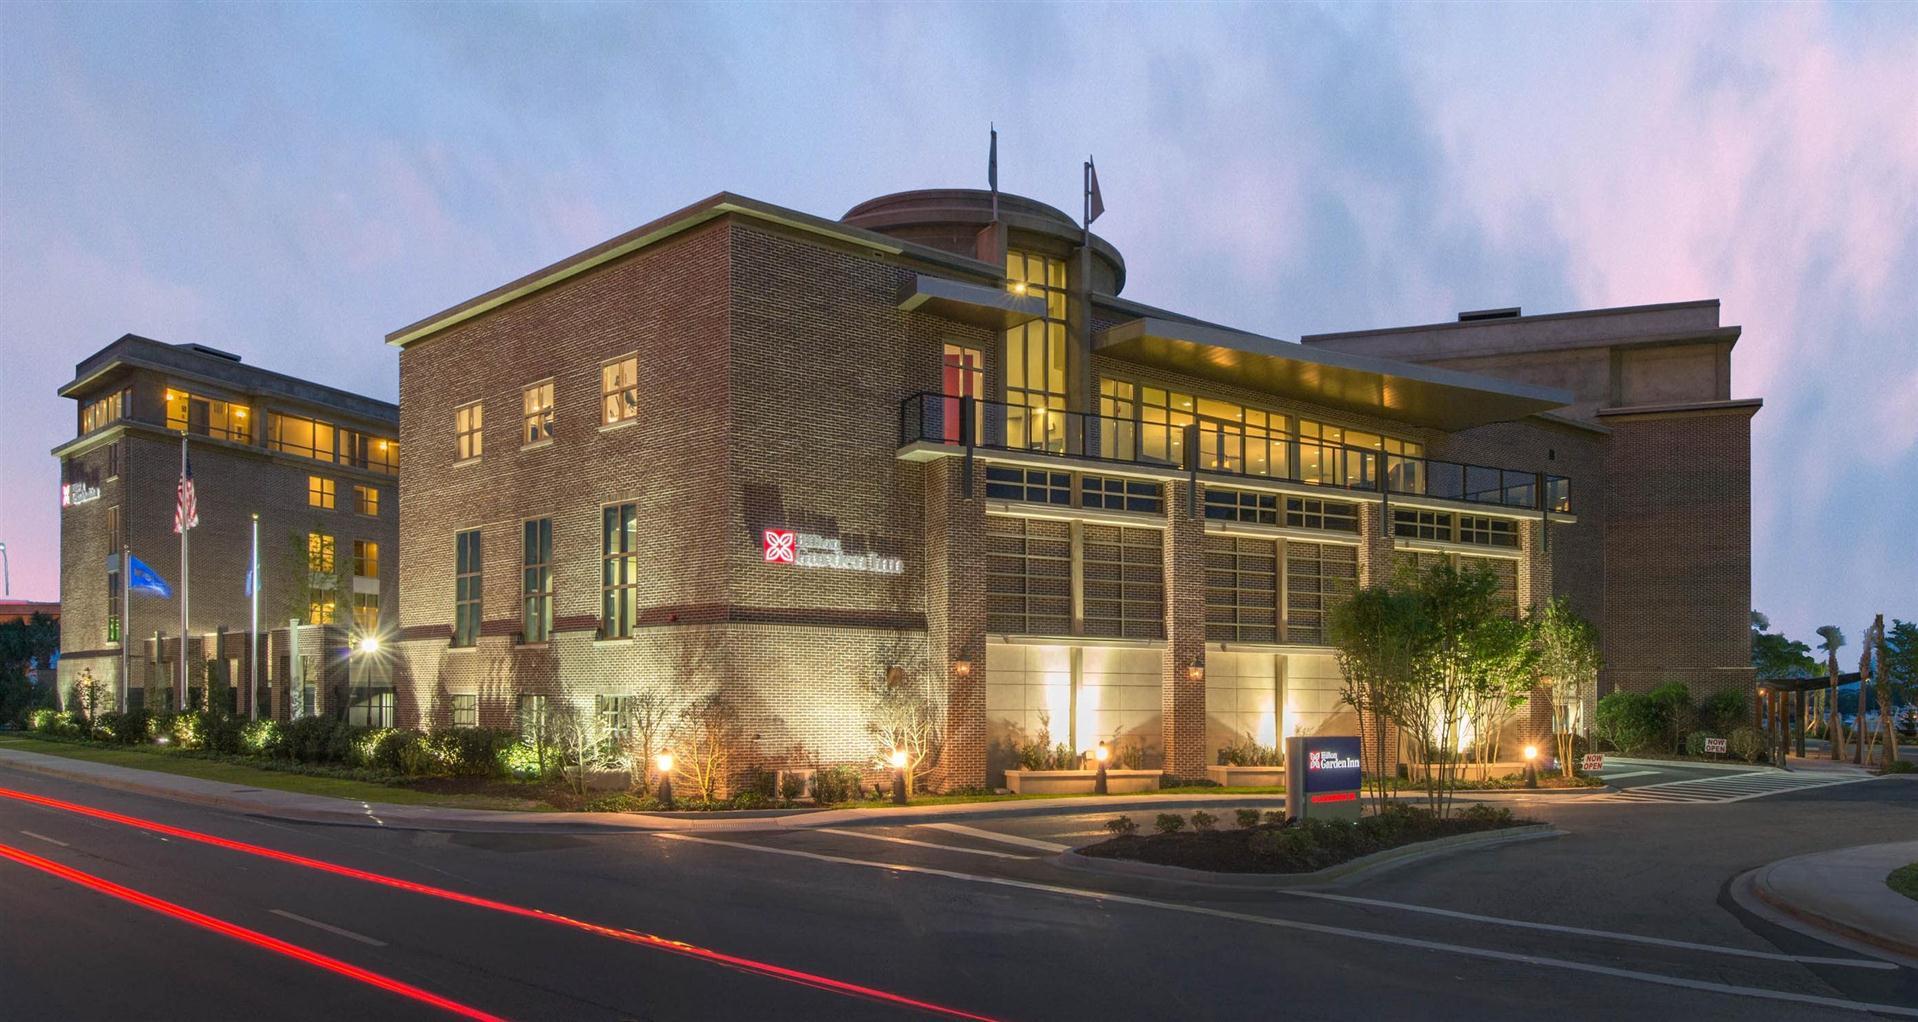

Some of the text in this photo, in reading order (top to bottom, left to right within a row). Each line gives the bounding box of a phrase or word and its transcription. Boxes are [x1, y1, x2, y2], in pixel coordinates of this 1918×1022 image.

[1320, 757, 1360, 769] Garden Inn
[1583, 762, 1603, 770] OPEN
